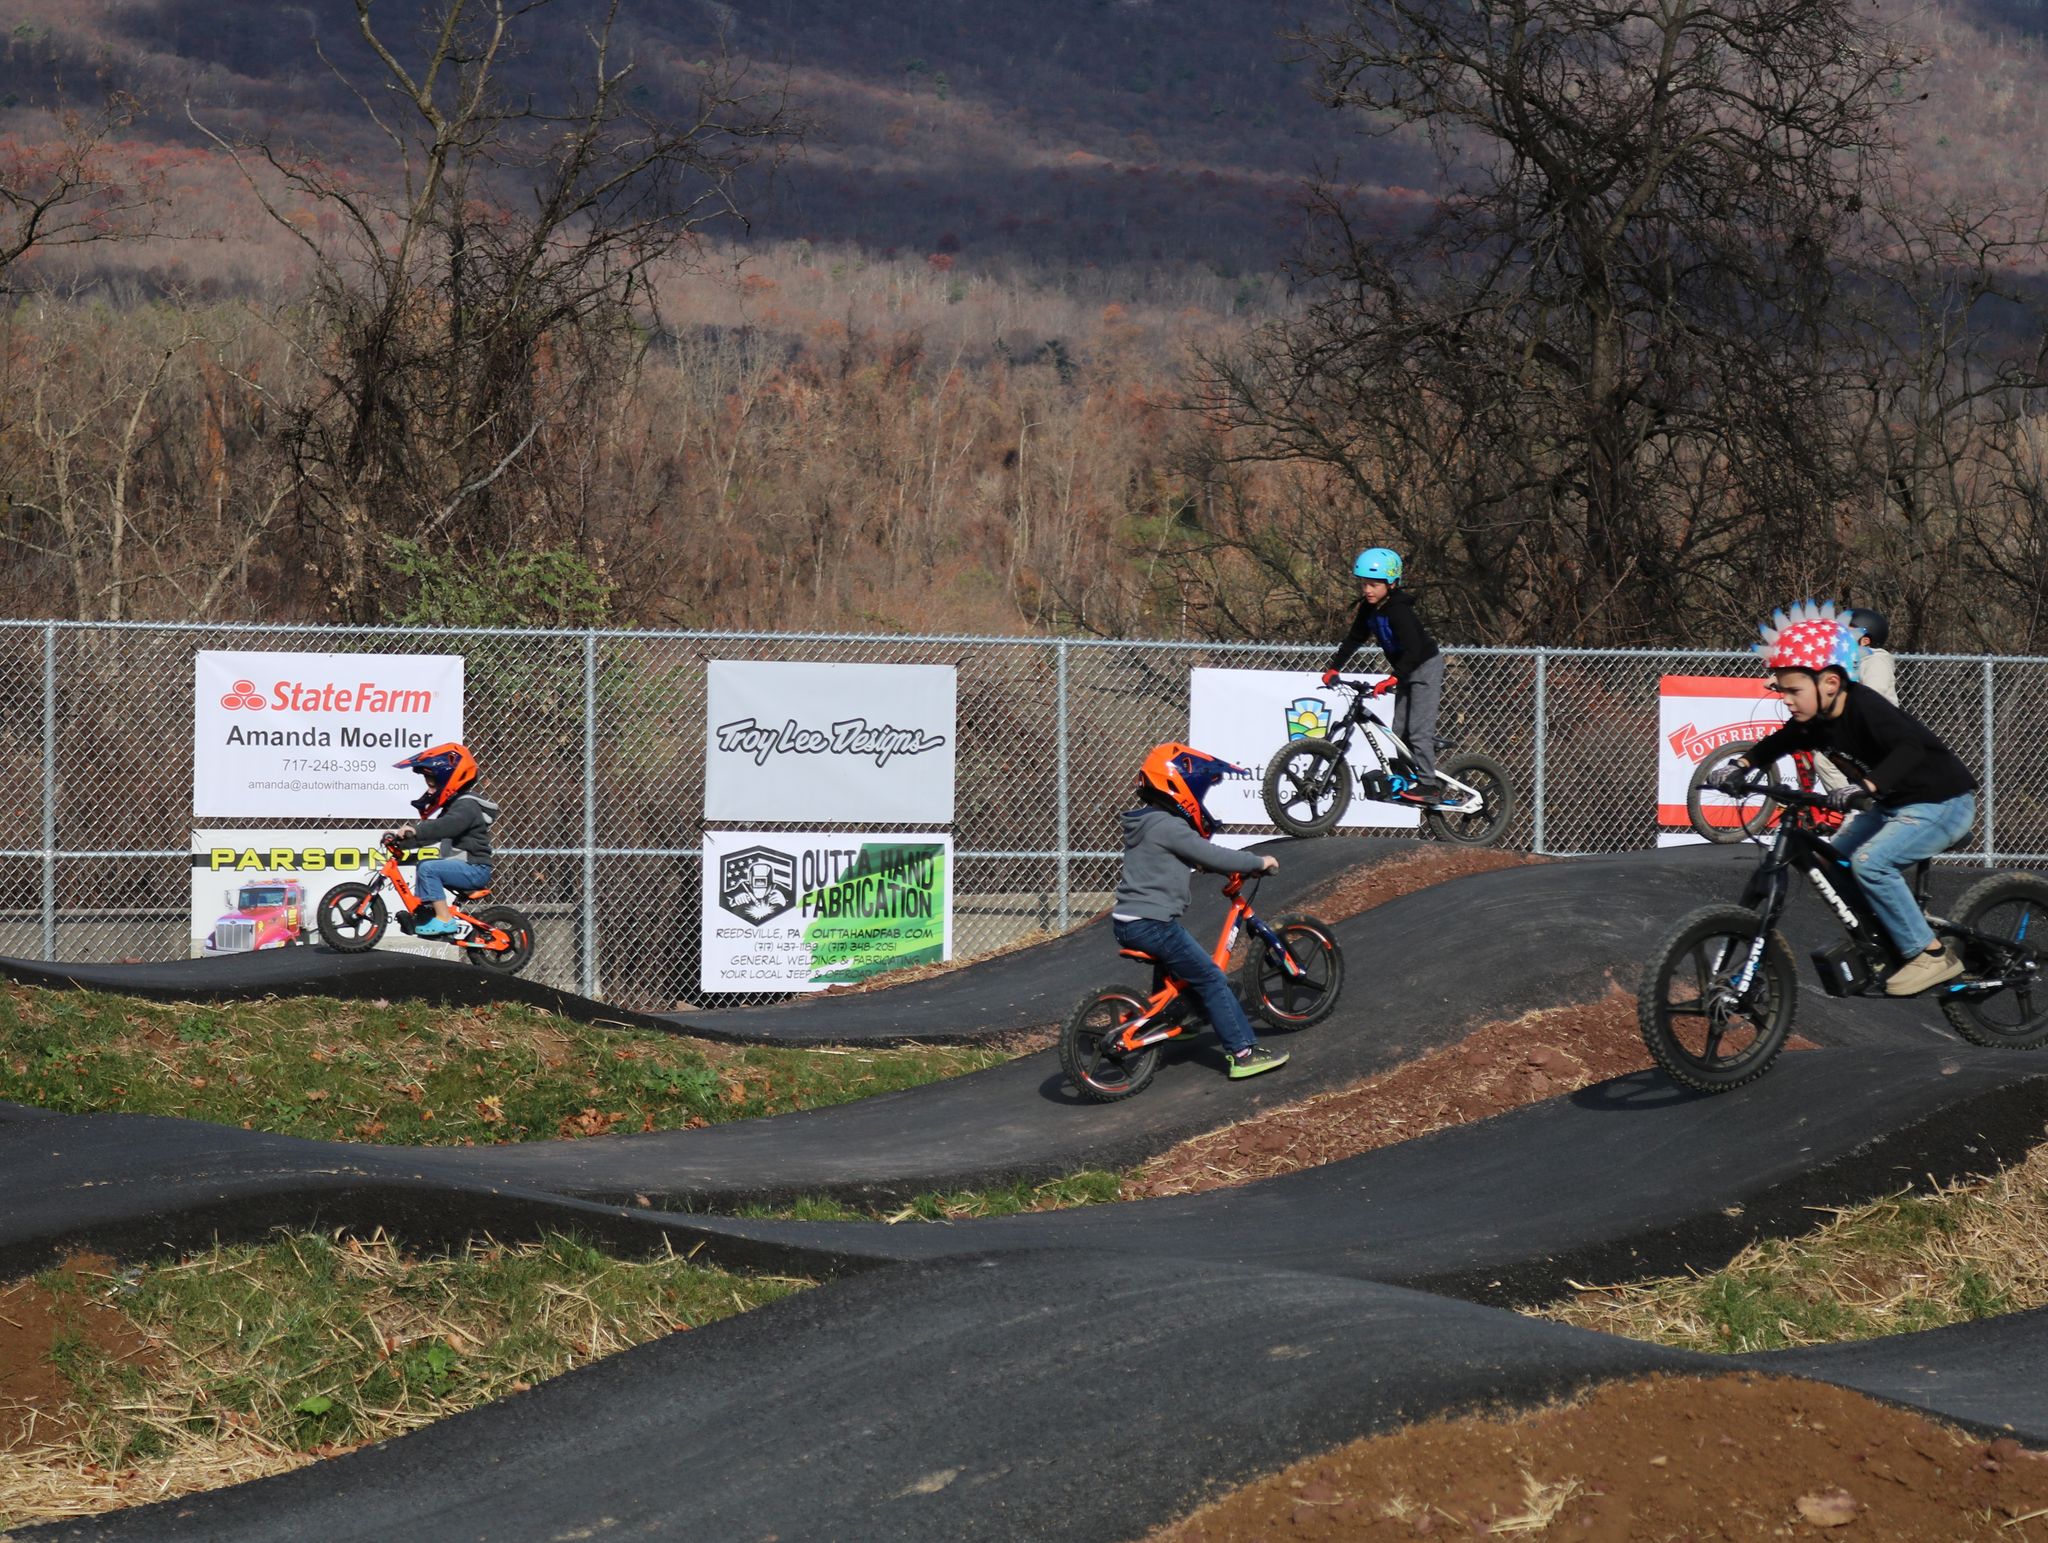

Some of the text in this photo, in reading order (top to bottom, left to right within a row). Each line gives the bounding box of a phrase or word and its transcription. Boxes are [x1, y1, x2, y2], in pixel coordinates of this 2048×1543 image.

[226, 725, 433, 749] Amanda Moeller
[717, 718, 946, 768] Troy Lee Designs
[283, 759, 376, 772] 717-248-3959
[248, 780, 409, 792] amanda@autowithamanda.com
[802, 848, 934, 892] OUTTA HAND
[802, 877, 932, 918] FABRICATION
[812, 928, 934, 939] OUTTAHANDFAB.COM
[754, 942, 774, 952] (717)
[731, 955, 783, 966] GENERAL
[787, 955, 836, 966] WELDING
[840, 955, 849, 965] &
[720, 969, 747, 979] YOUR
[750, 969, 783, 979] LOCAL
[786, 969, 812, 979] JEEP
[815, 969, 823, 979] &
